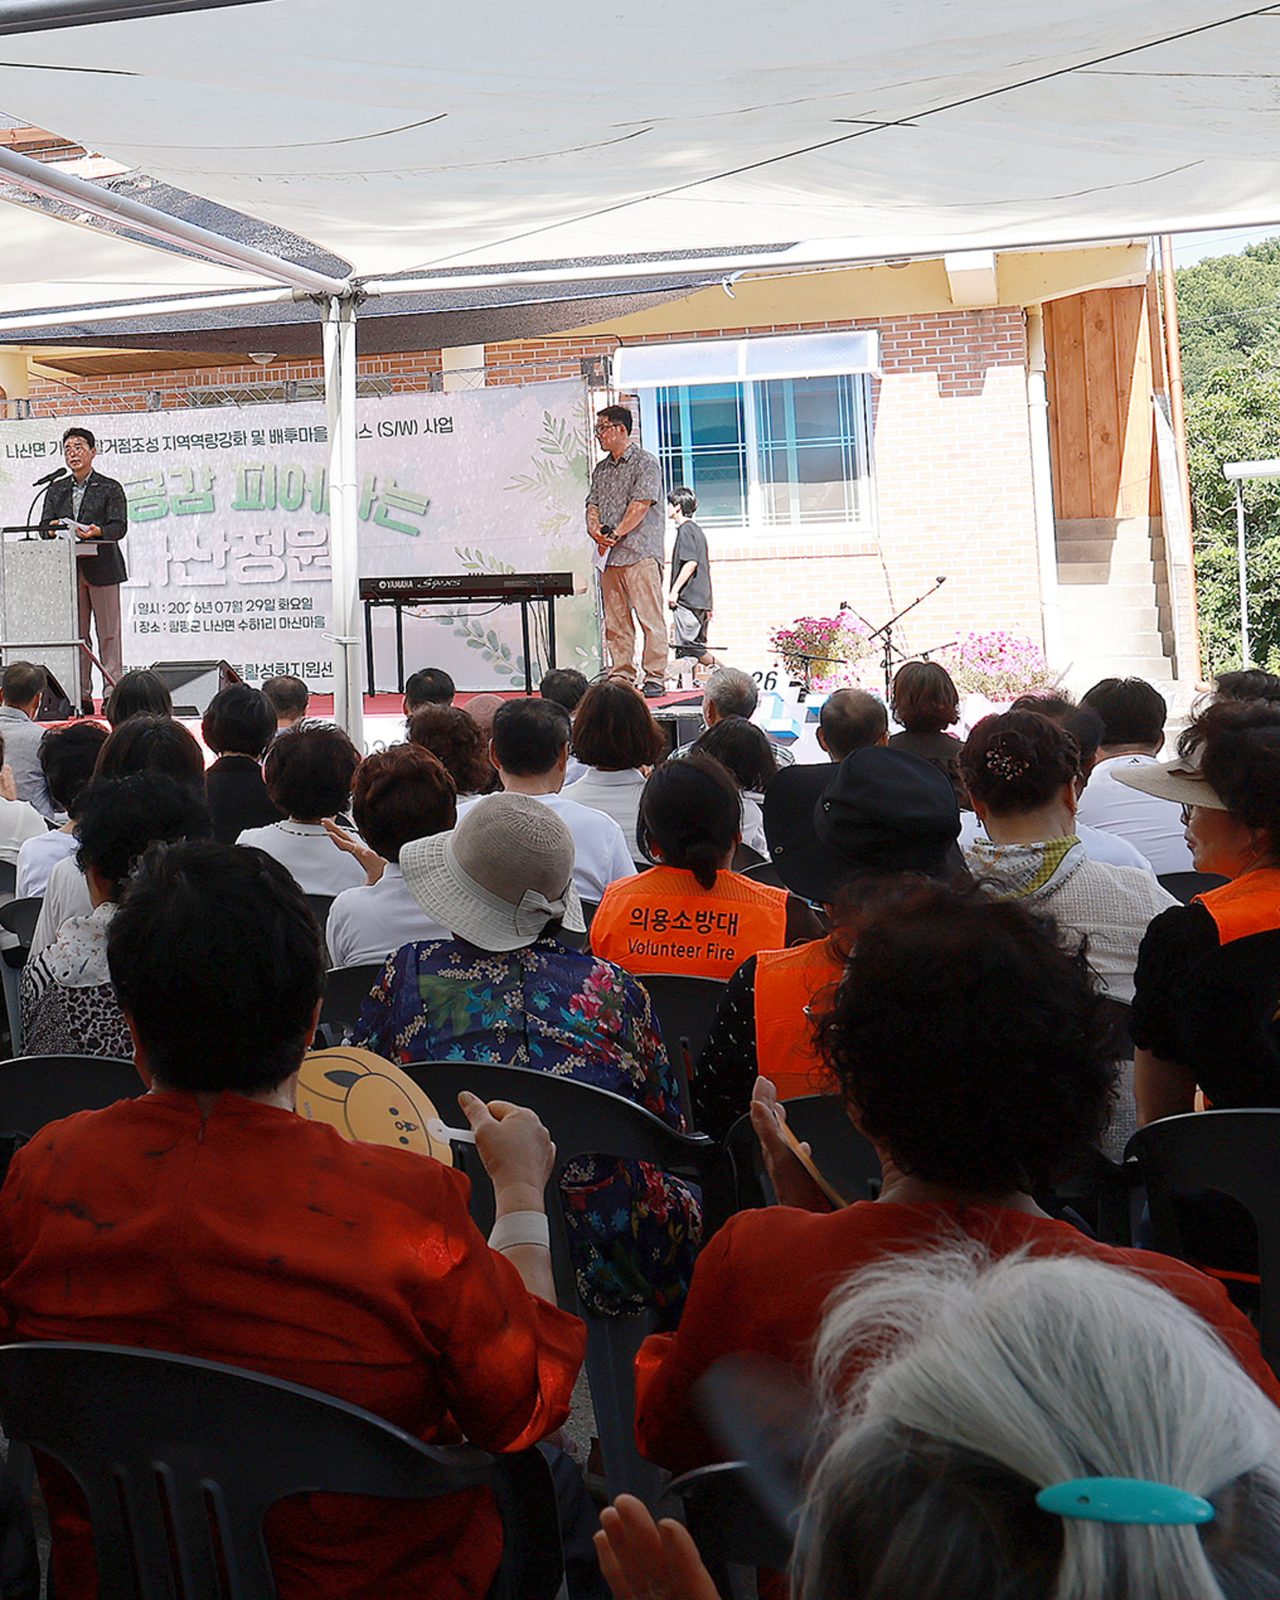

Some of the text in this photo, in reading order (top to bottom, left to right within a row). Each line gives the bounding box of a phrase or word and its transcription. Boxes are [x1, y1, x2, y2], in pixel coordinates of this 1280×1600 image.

[5, 441, 46, 459] 나산면
[162, 430, 248, 451] 지역역량강화
[251, 429, 266, 447] 및
[377, 419, 418, 438] (S/W)
[423, 416, 454, 435] 사업
[387, 580, 414, 589] YAMAHA
[214, 600, 243, 614] 07월
[246, 598, 276, 612] 29일
[278, 597, 313, 611] 화요일
[203, 619, 235, 632] 나산면
[280, 615, 325, 630] 마산마을
[629, 907, 739, 937] 의용소방대
[628, 939, 735, 961] Volunteer Fire
